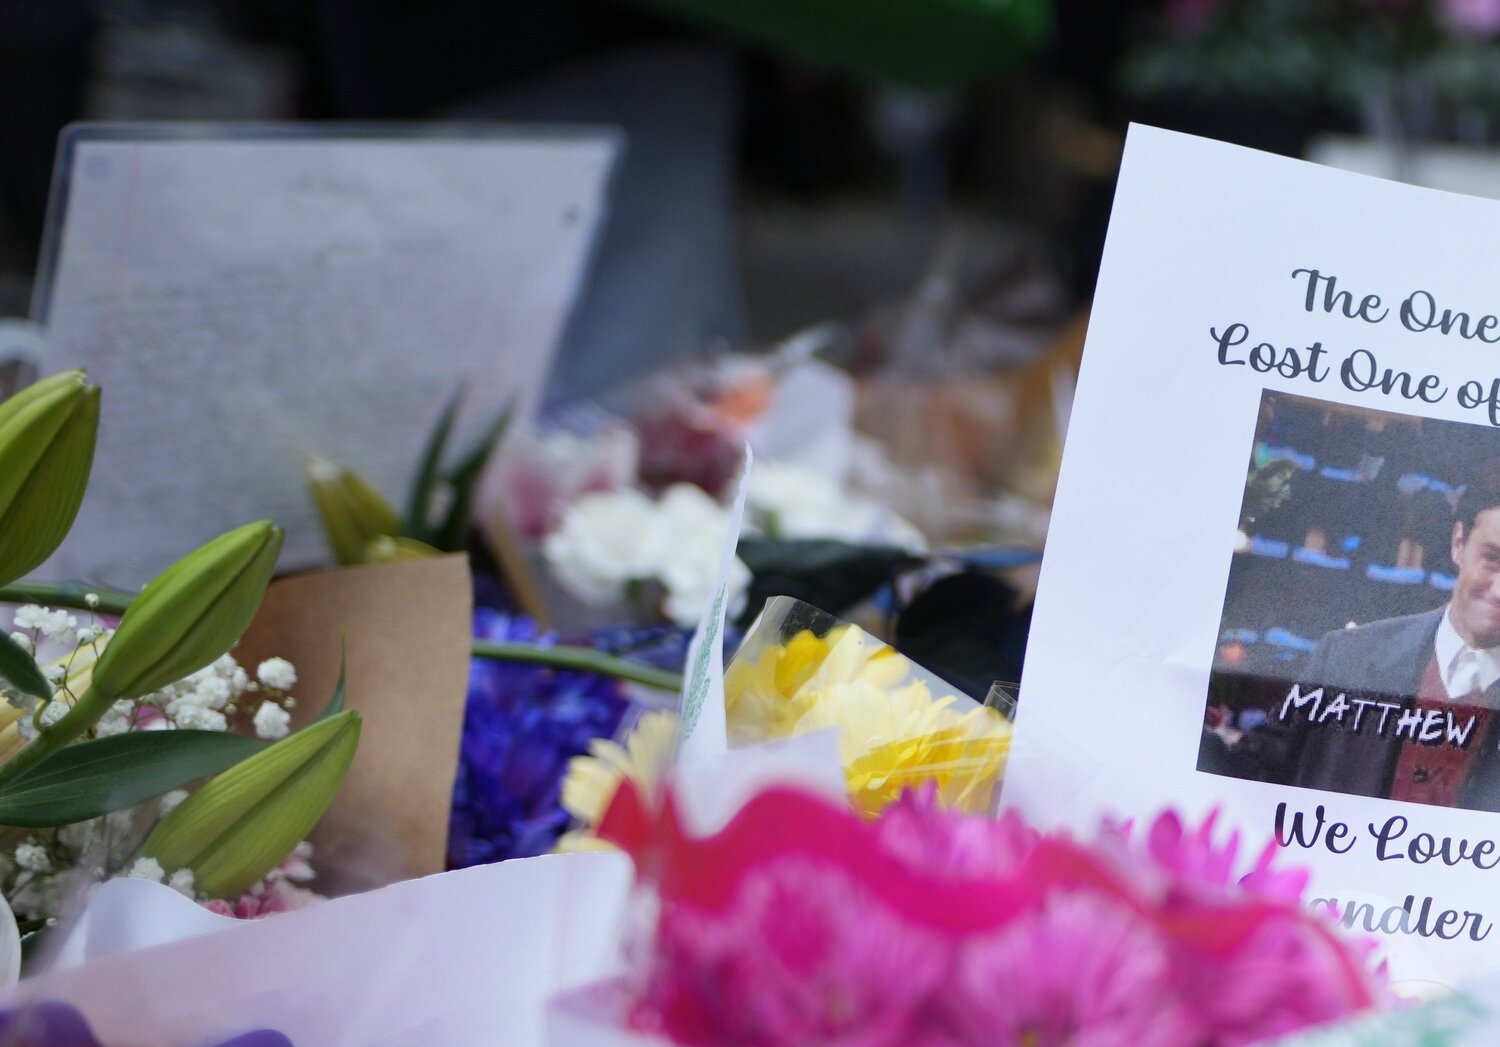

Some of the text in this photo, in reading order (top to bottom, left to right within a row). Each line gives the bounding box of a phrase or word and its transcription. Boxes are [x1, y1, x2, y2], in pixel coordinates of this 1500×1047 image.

[1291, 268, 1389, 323] The
[1209, 323, 1330, 383] Lost
[1340, 349, 1448, 404] One
[1279, 684, 1477, 748] MATTHEW
[1274, 802, 1357, 854] We
[1303, 893, 1492, 942] ndler
